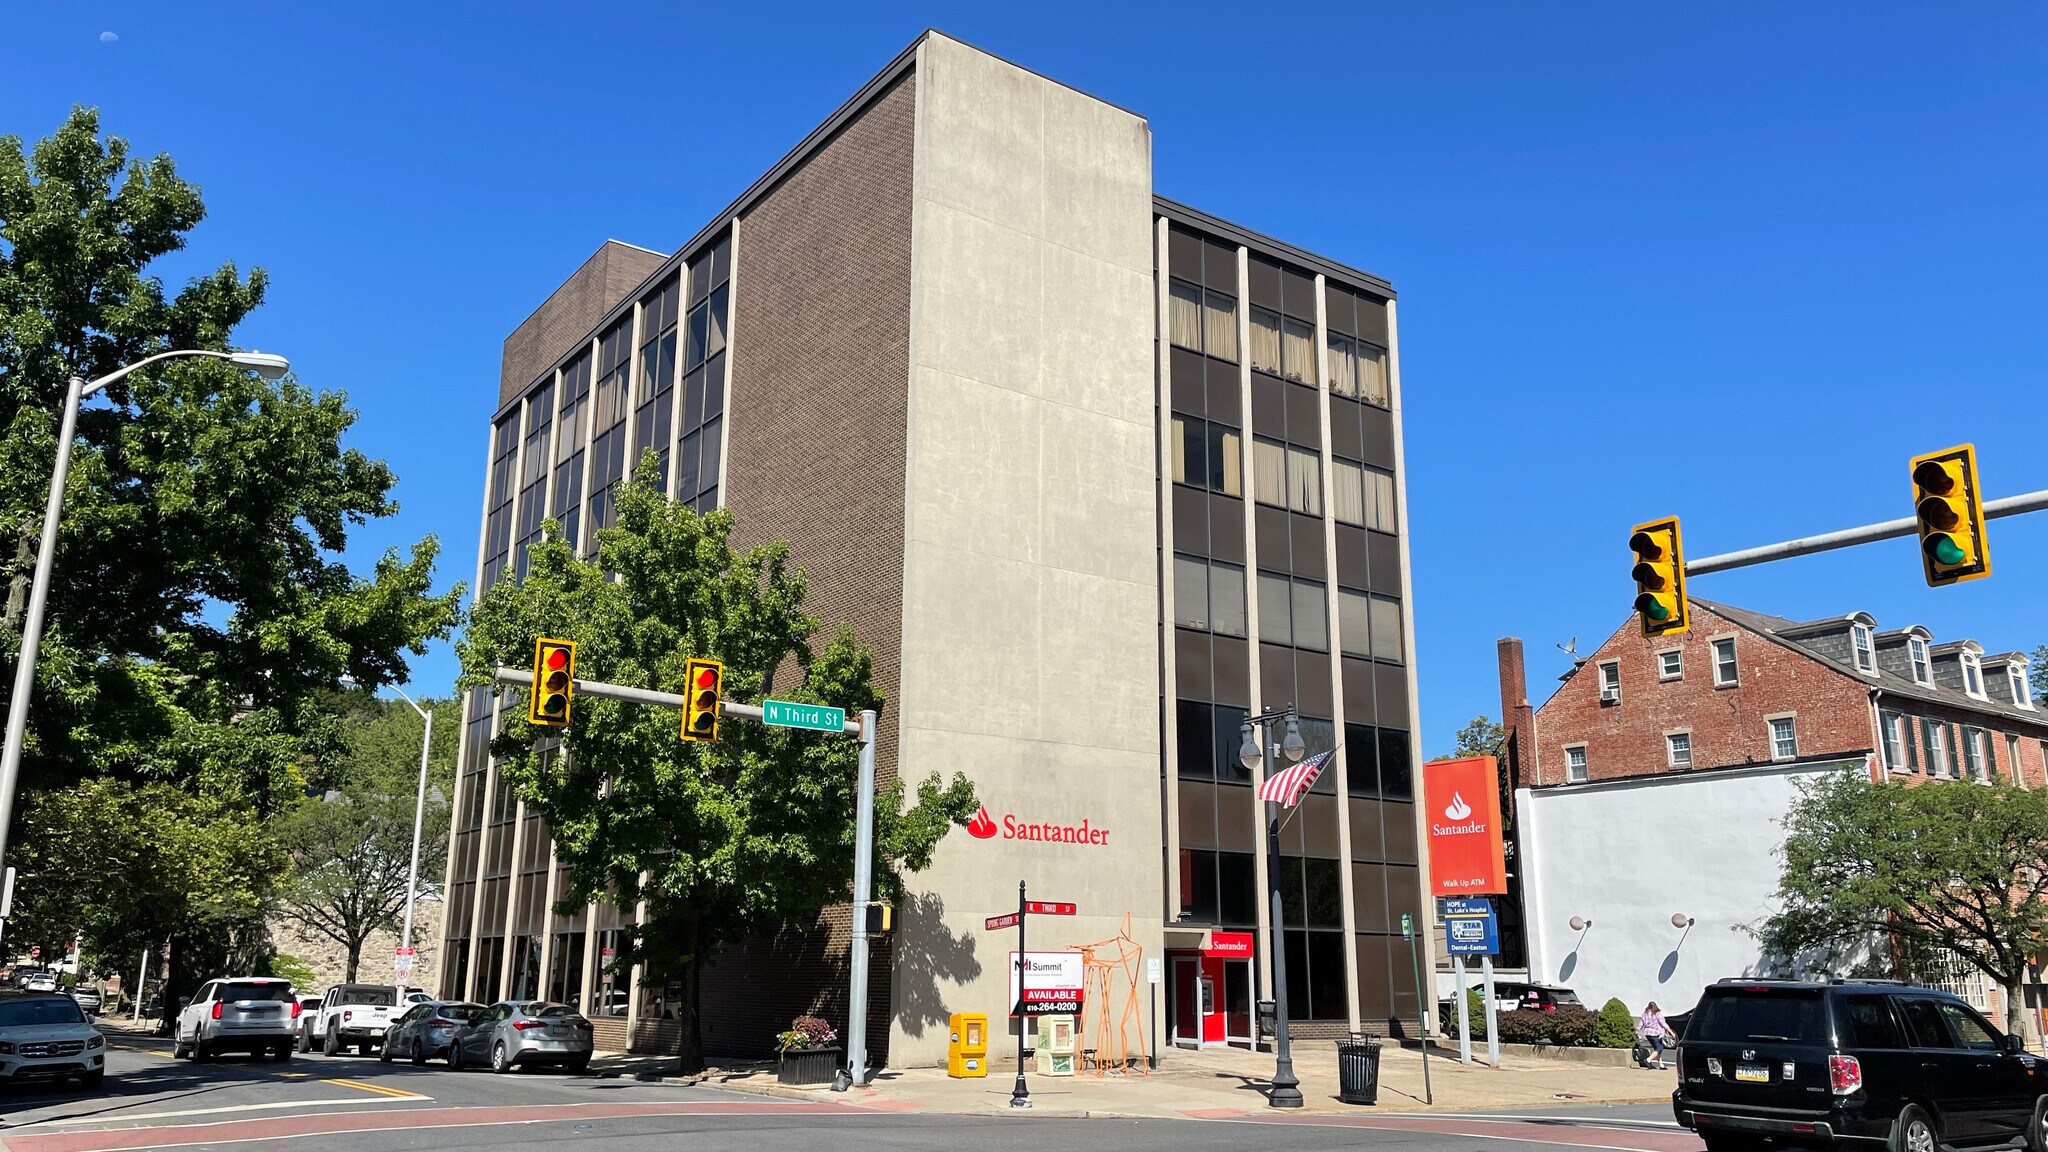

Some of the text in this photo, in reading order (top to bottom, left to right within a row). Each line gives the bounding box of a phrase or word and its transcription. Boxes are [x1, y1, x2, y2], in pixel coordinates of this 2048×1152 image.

[770, 706, 838, 726] N Third St
[1003, 814, 1110, 845] Santander
[1433, 820, 1486, 836] Santander
[1442, 878, 1485, 888] Walk Up ATM
[1042, 904, 1056, 912] THIRD
[986, 918, 998, 928] SPRING
[1000, 916, 1012, 926] GARDEN
[1213, 940, 1248, 951] Santander
[1032, 962, 1062, 971] Summit
[1027, 990, 1077, 1000] AVAILABLE
